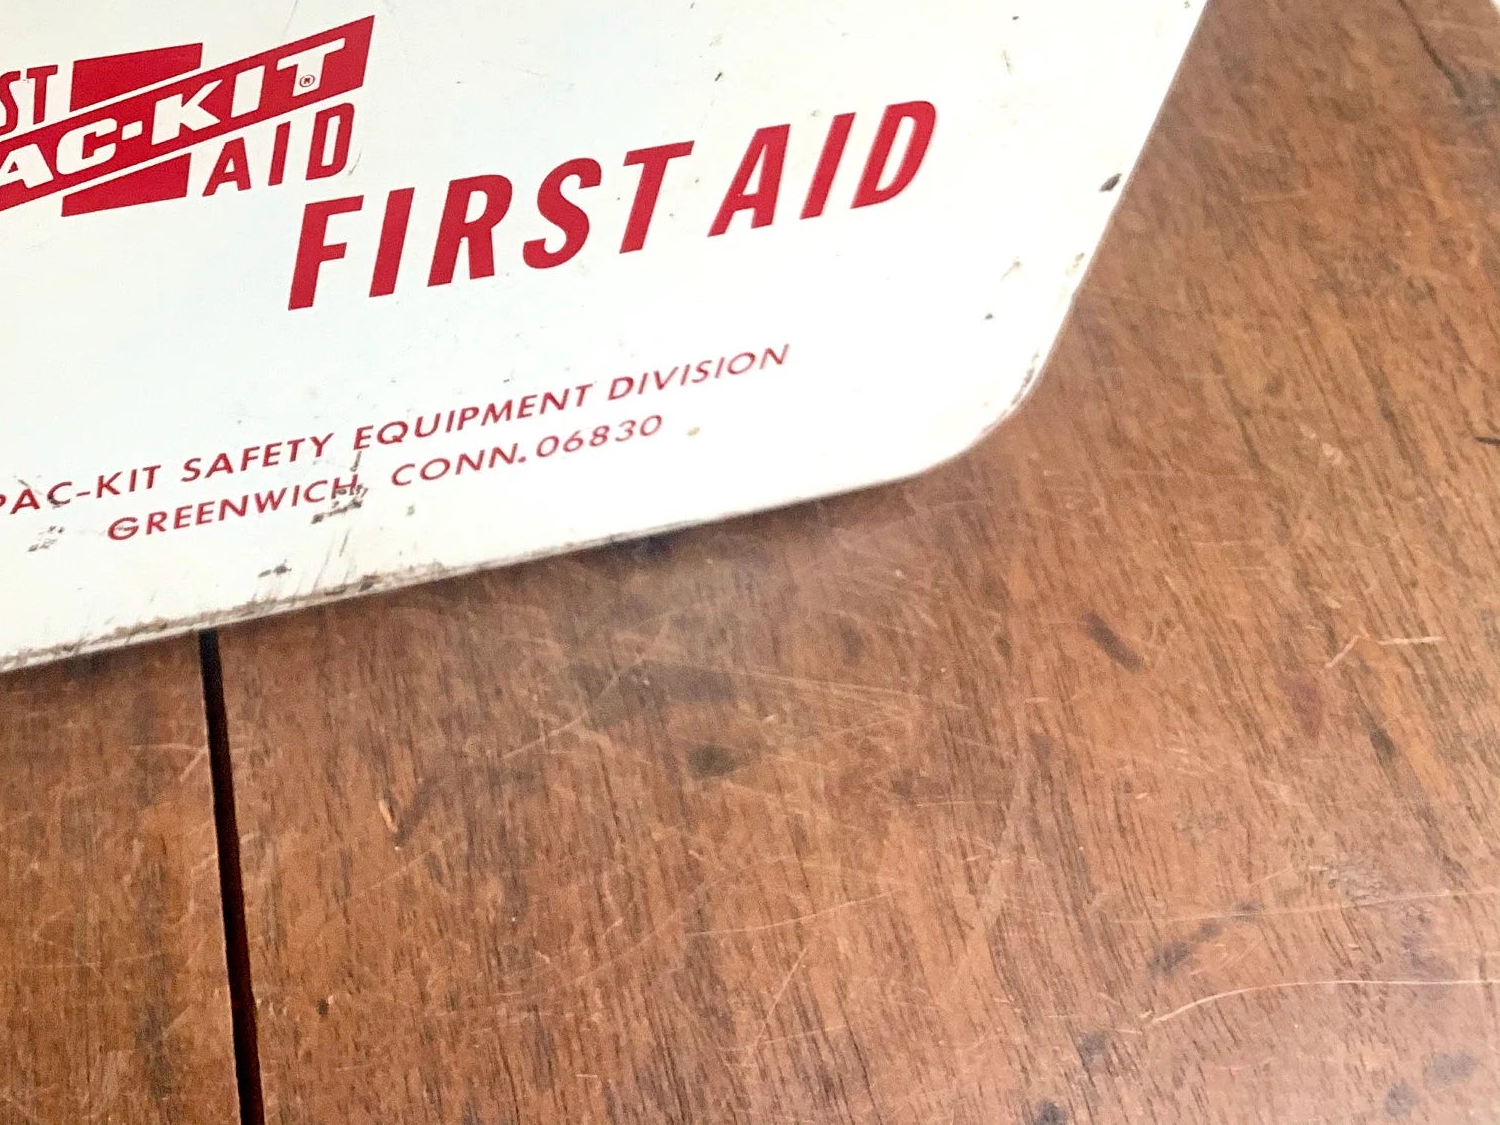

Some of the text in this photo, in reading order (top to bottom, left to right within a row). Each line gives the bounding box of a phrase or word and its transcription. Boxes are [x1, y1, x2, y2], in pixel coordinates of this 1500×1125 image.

[202, 102, 356, 197] AID
[287, 100, 938, 311] FIRST AID
[181, 432, 334, 483] SAFETY
[353, 383, 594, 451] EQUIPMENT
[607, 343, 791, 401] DIVISION
